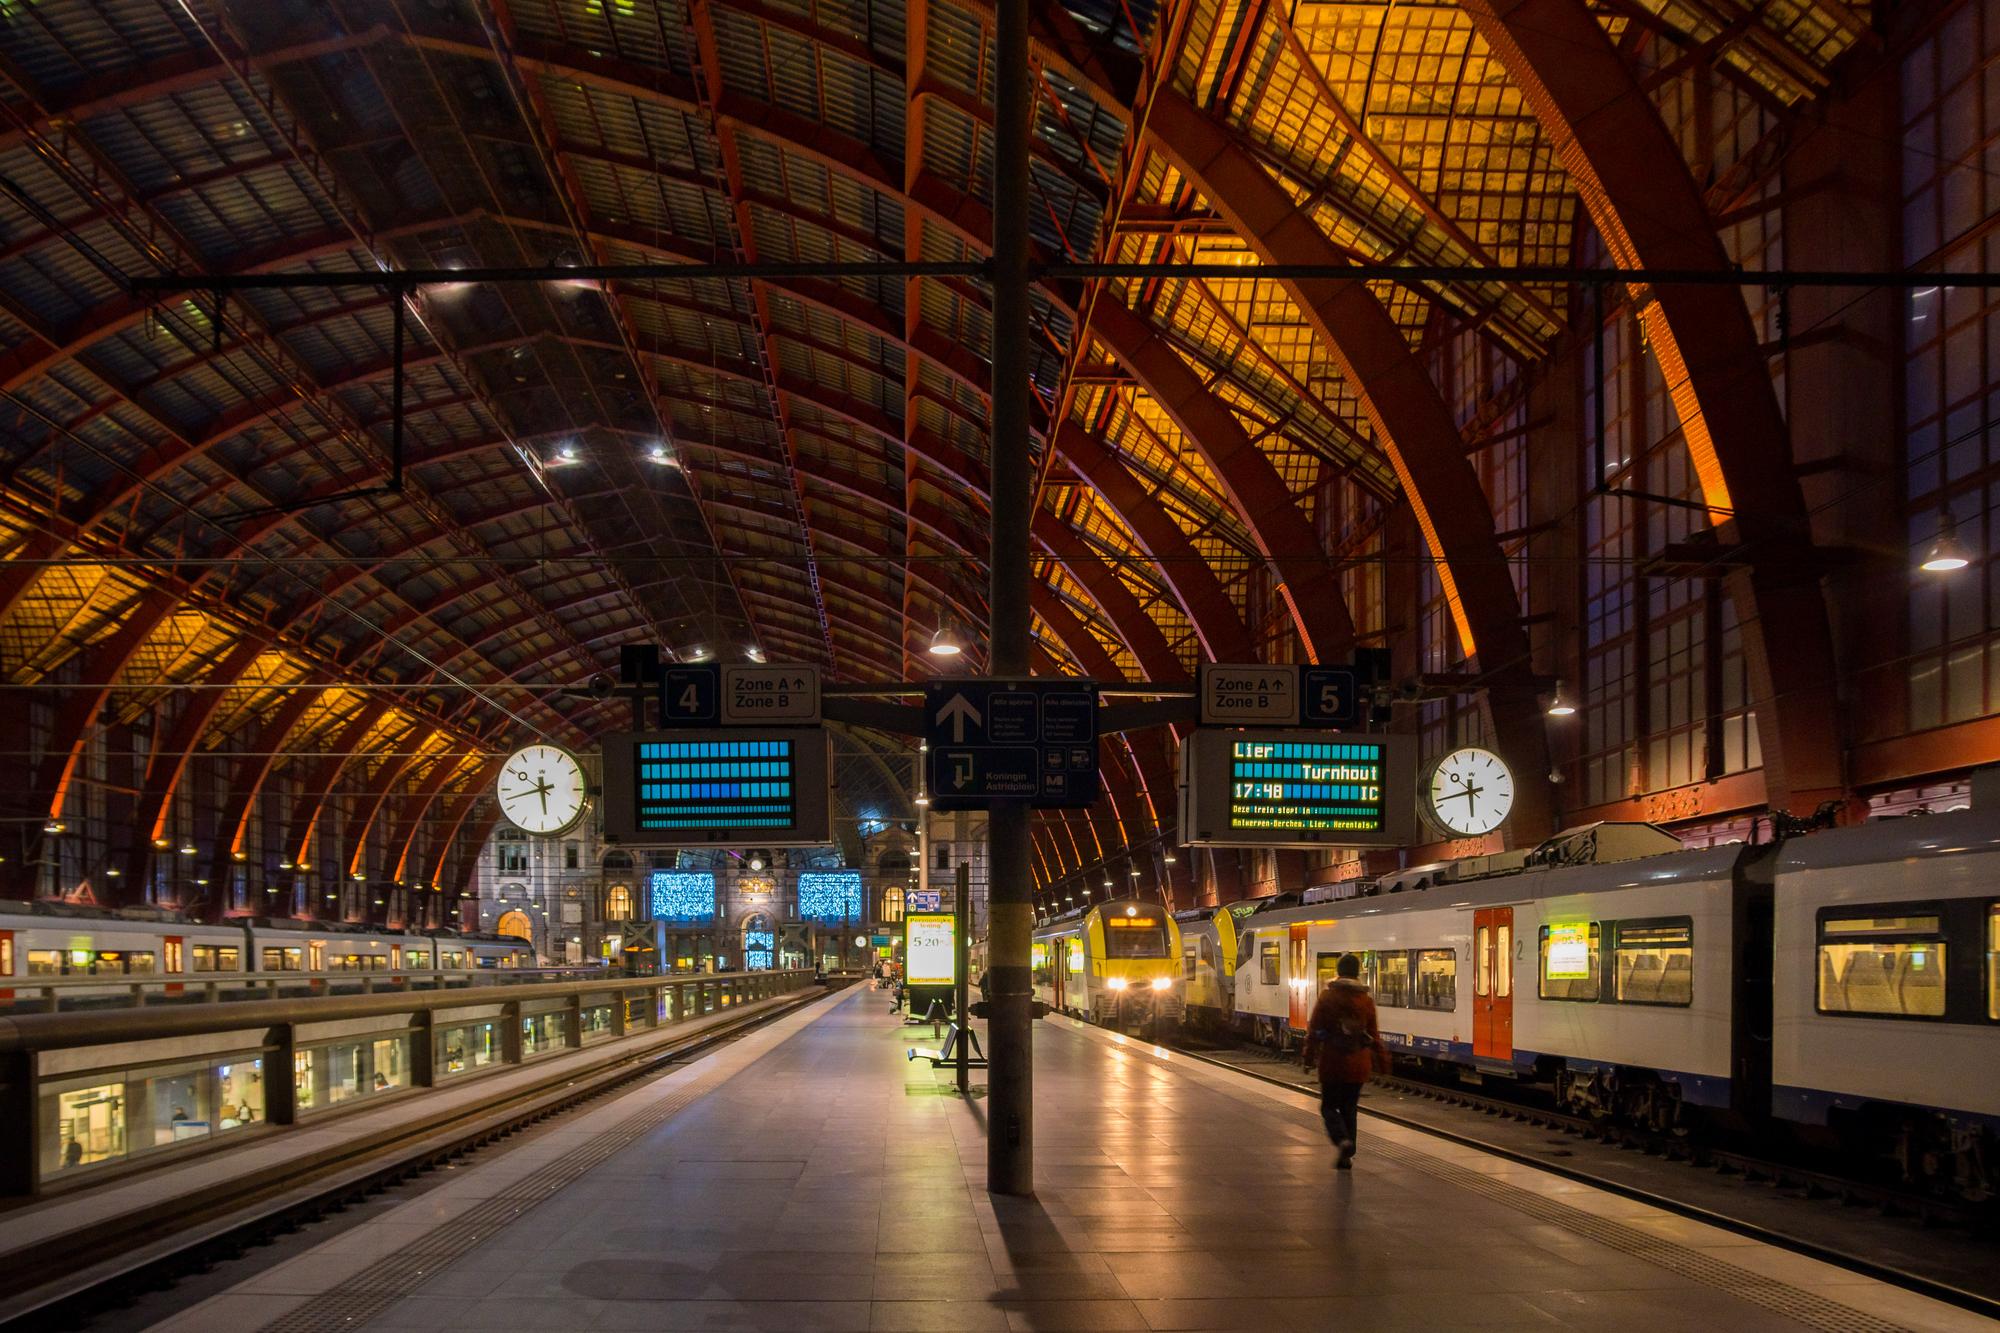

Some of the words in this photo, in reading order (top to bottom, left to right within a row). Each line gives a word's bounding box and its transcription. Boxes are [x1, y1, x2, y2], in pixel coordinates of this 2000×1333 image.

[735, 678, 773, 690] Zone
[778, 678, 788, 690] A
[1216, 678, 1253, 690] Zone
[1258, 678, 1268, 690] A
[678, 682, 700, 714] 4
[735, 695, 773, 707] Zone
[778, 695, 788, 707] B
[1216, 695, 1253, 708] Zone
[1258, 696, 1269, 708] B
[1320, 684, 1340, 714] 5
[1234, 742, 1274, 758] Lier
[1302, 764, 1377, 780] Turnhout
[1236, 784, 1282, 798] 17:48
[1361, 786, 1378, 800] IC
[1233, 805, 1250, 813] Deze
[1254, 806, 1274, 814] trein
[1278, 806, 1298, 814] stopt
[1302, 806, 1310, 814] in
[1465, 942, 1471, 961] 2
[1516, 940, 1523, 960] 2
